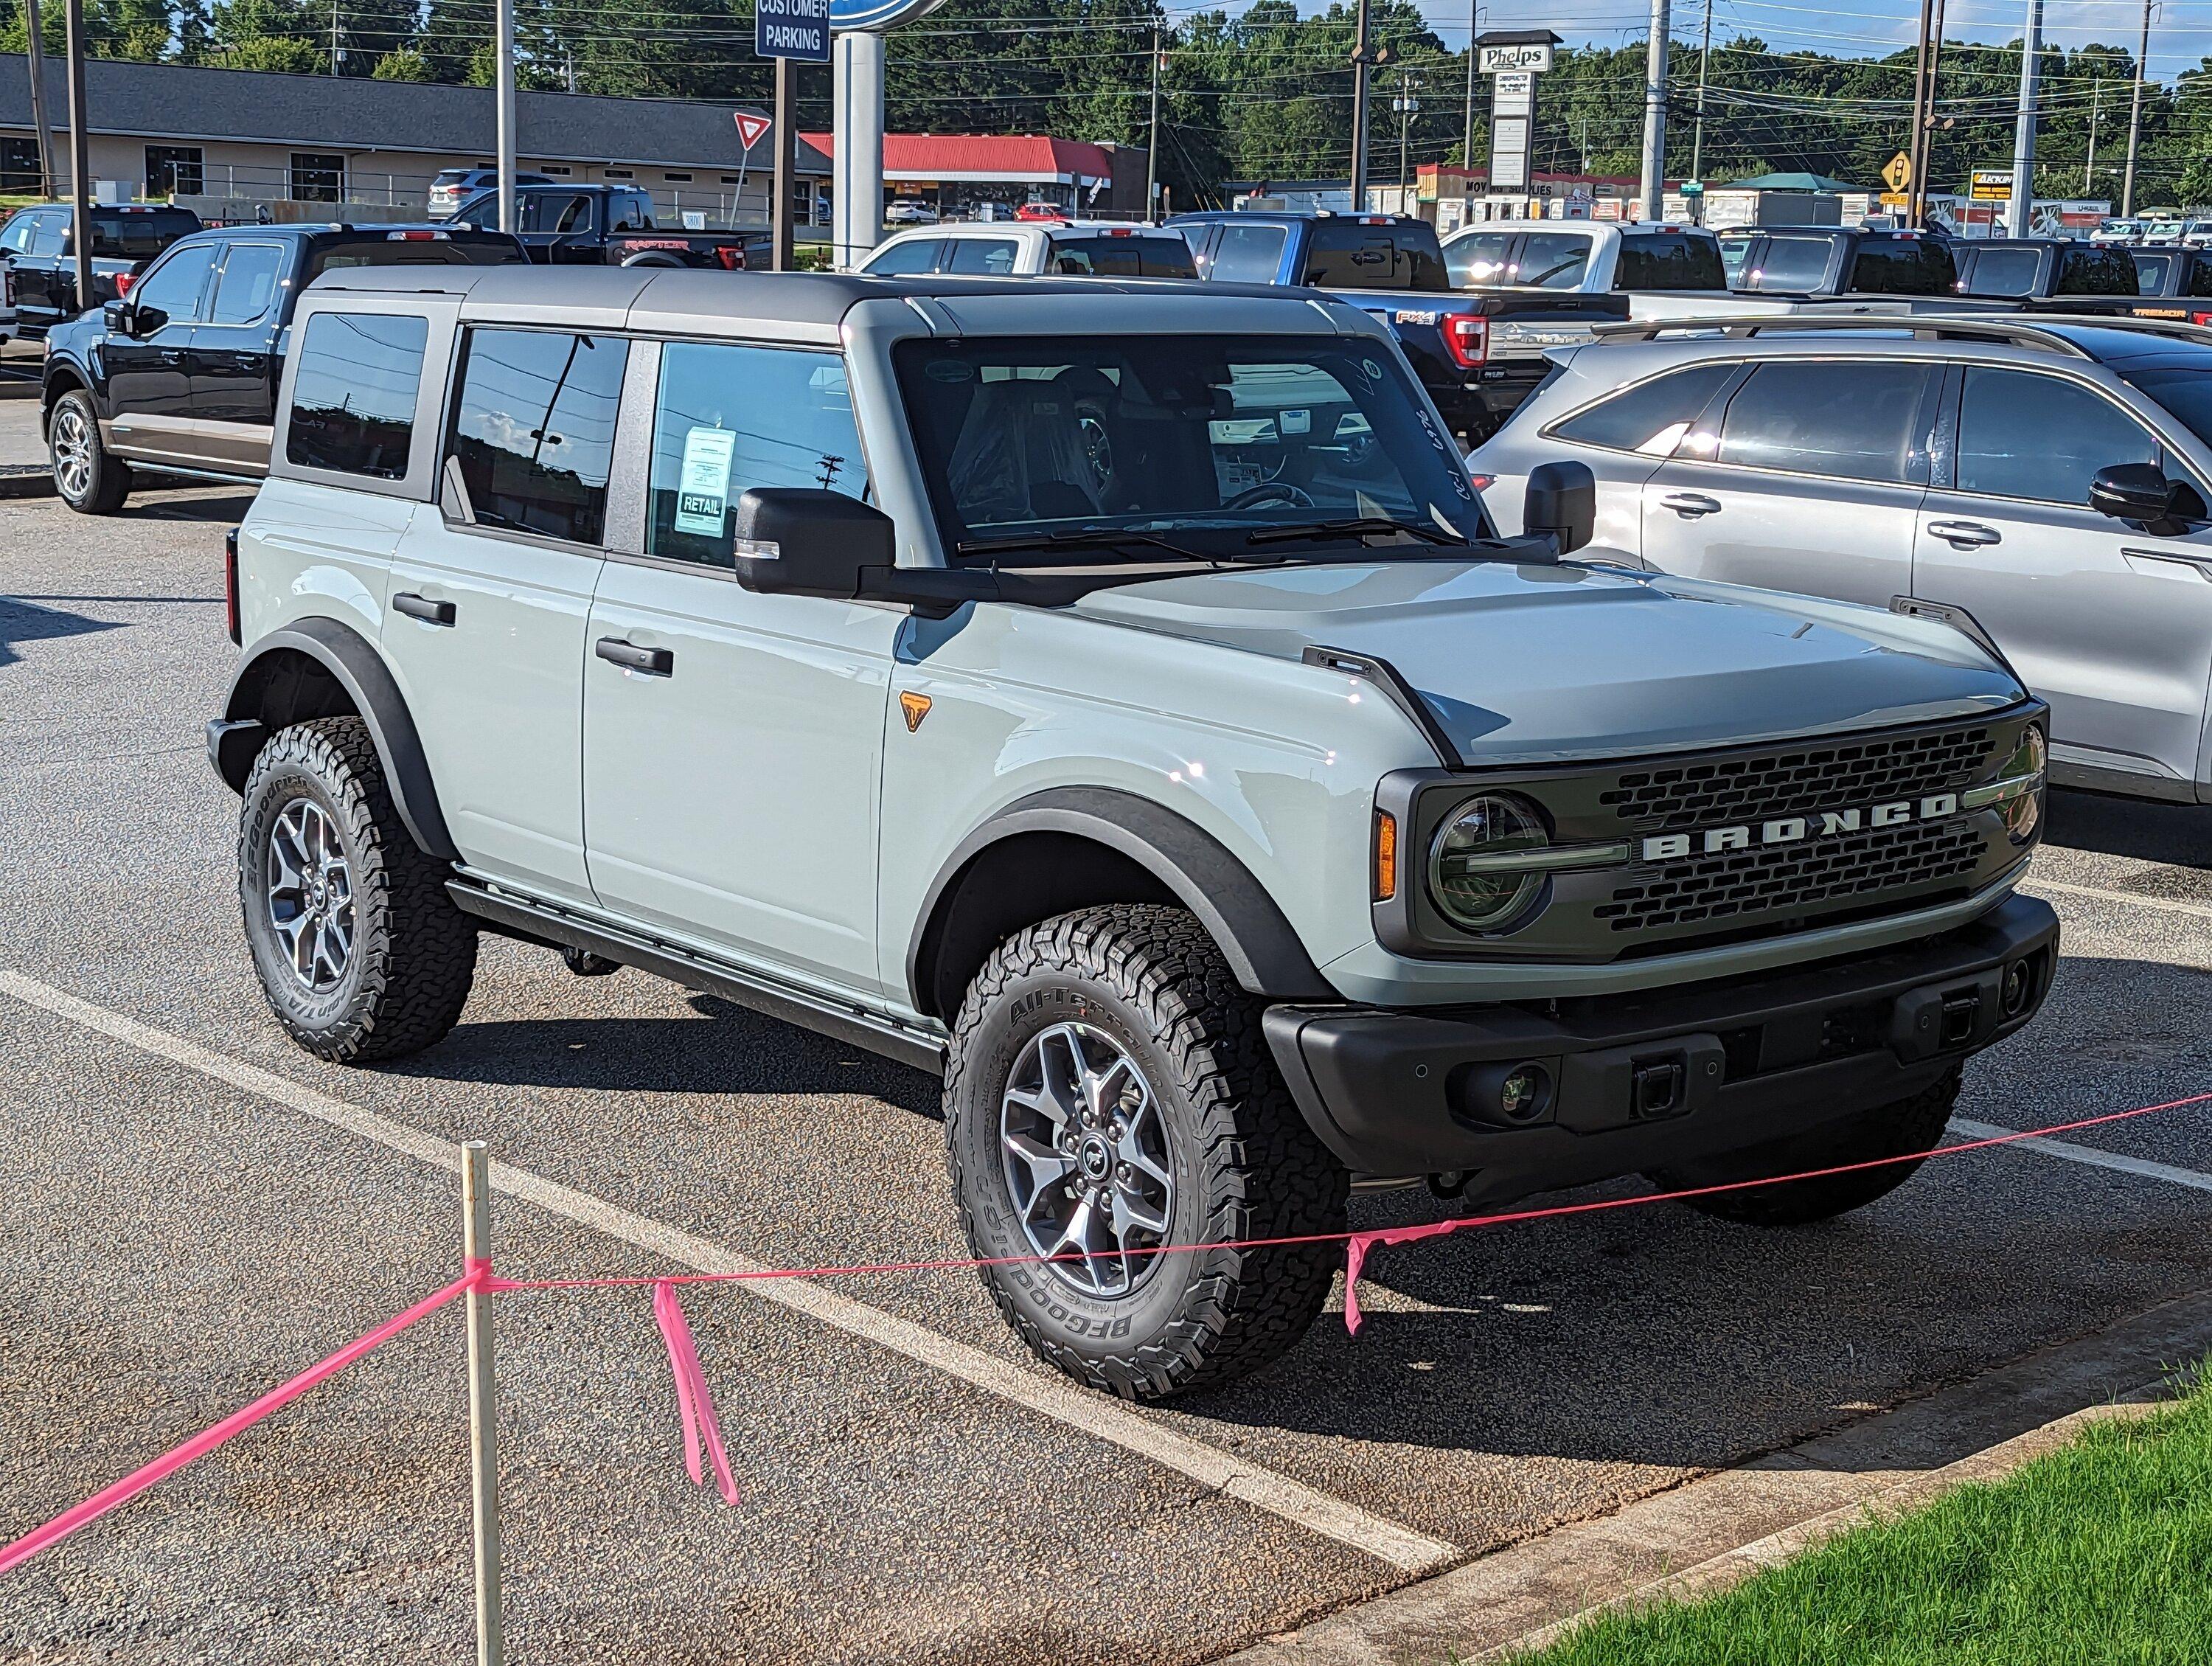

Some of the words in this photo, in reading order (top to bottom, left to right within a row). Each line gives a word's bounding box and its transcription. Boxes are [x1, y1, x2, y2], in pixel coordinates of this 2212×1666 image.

[759, 0, 828, 18] CUSTOMER
[765, 24, 821, 51] PARKING
[1486, 46, 1542, 66] Phelps
[1466, 181, 1503, 194] MOVNG
[1395, 310, 1436, 325] FX4
[2132, 308, 2187, 318] TREMOR
[684, 496, 720, 515] RETAIL
[1643, 794, 1957, 861] BRONCO
